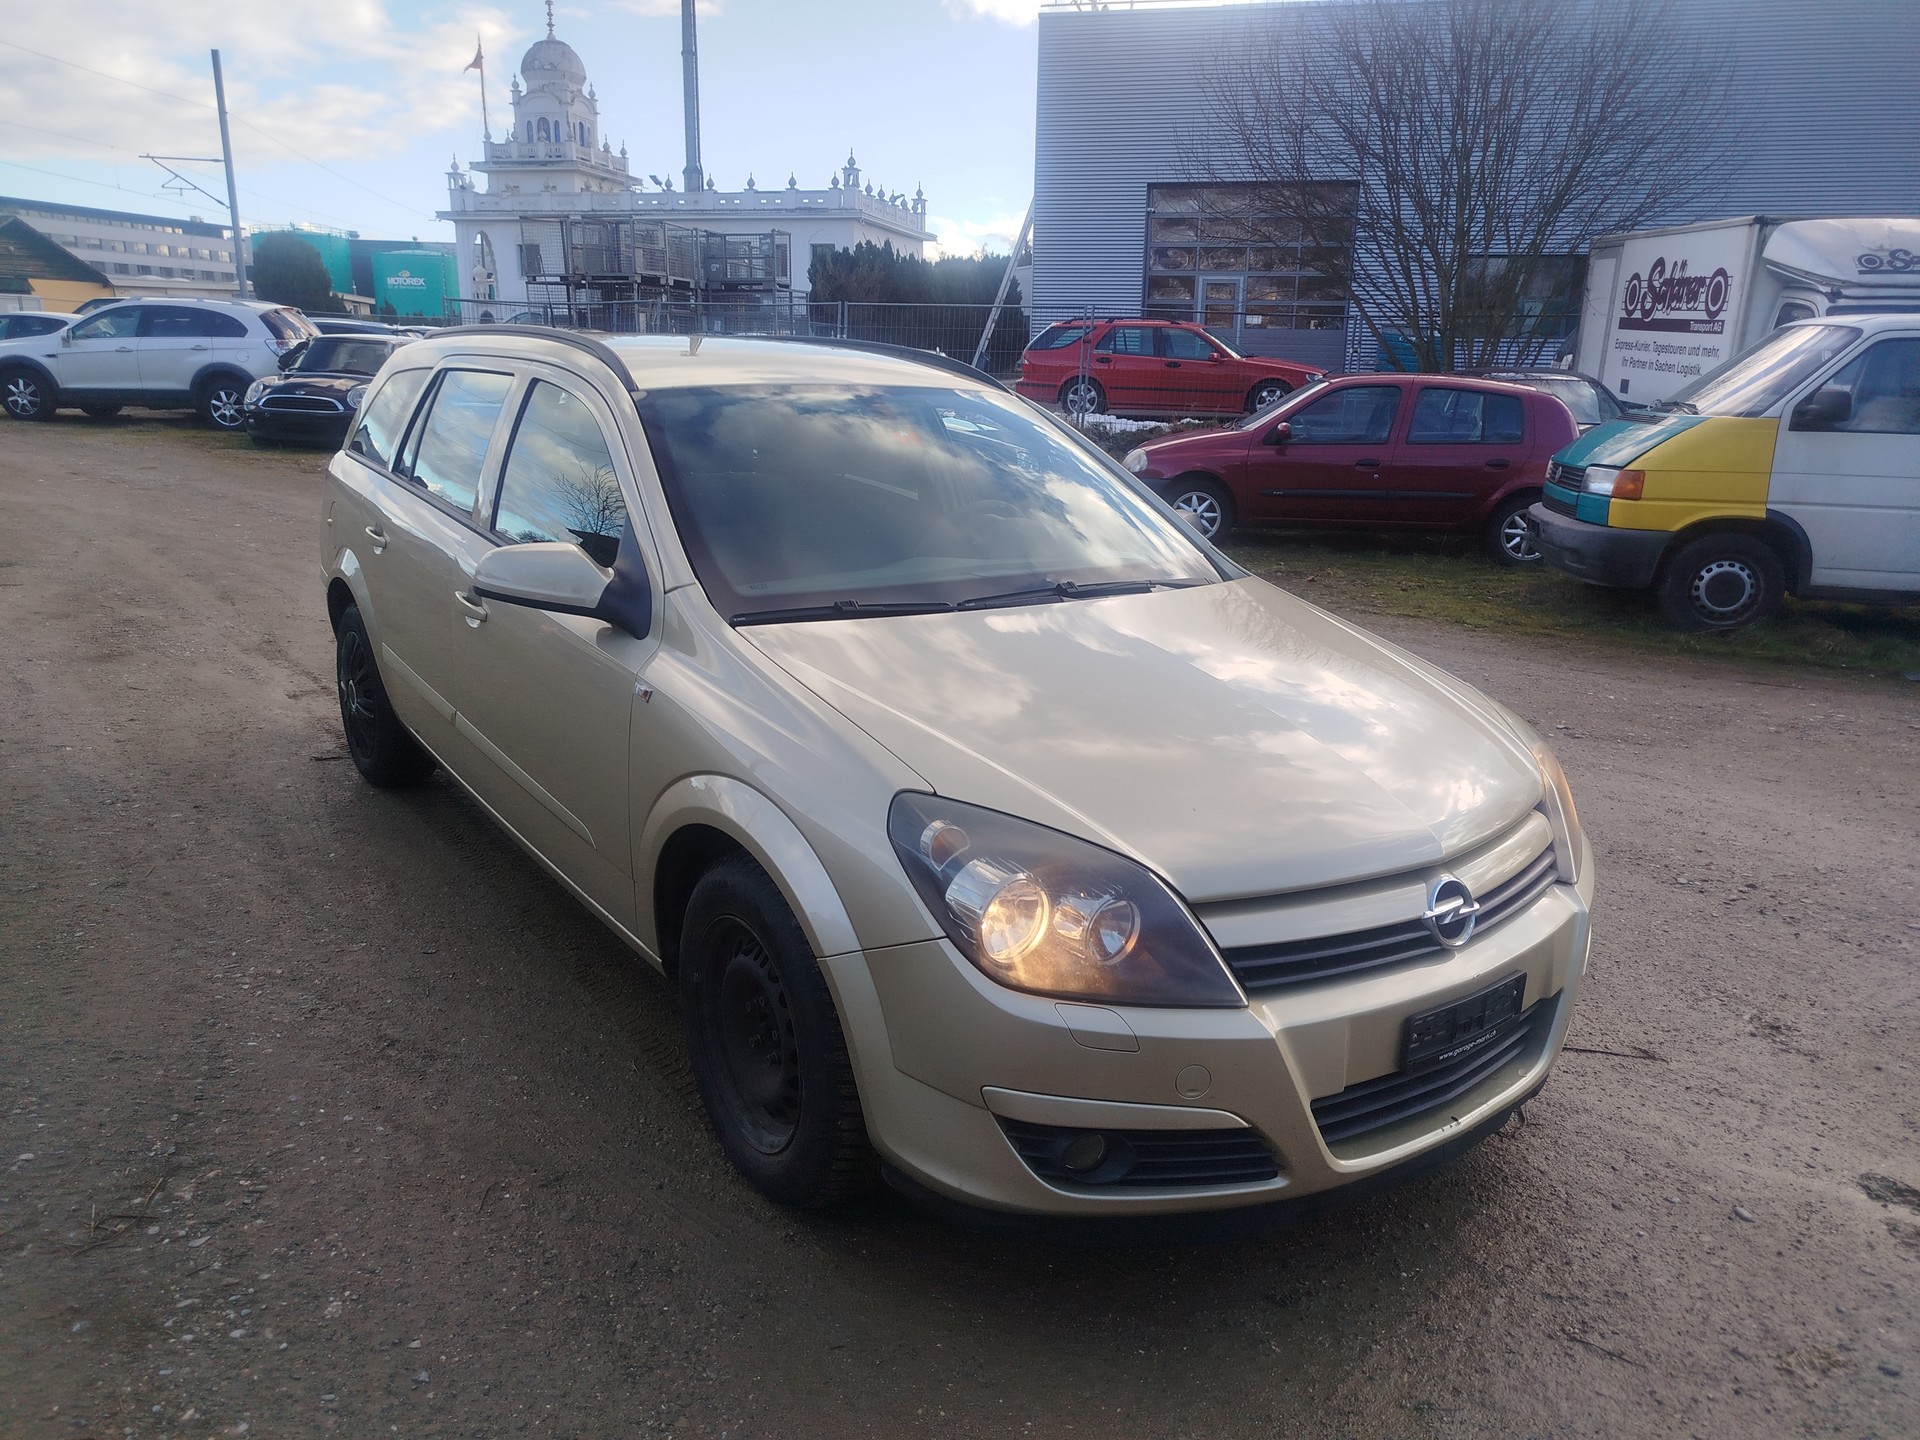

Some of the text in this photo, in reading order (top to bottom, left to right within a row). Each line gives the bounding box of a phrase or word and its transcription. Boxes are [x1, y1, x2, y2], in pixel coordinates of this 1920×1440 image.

[387, 277, 425, 285] MOTOREX
[1690, 321, 1722, 333] Transport AG
[1652, 341, 1686, 356] Tagestouren
[1687, 345, 1701, 357] und
[1701, 345, 1720, 359] mehr,
[1629, 357, 1648, 370] Partner
[1648, 358, 1654, 370] in
[1655, 360, 1676, 373] Sachen
